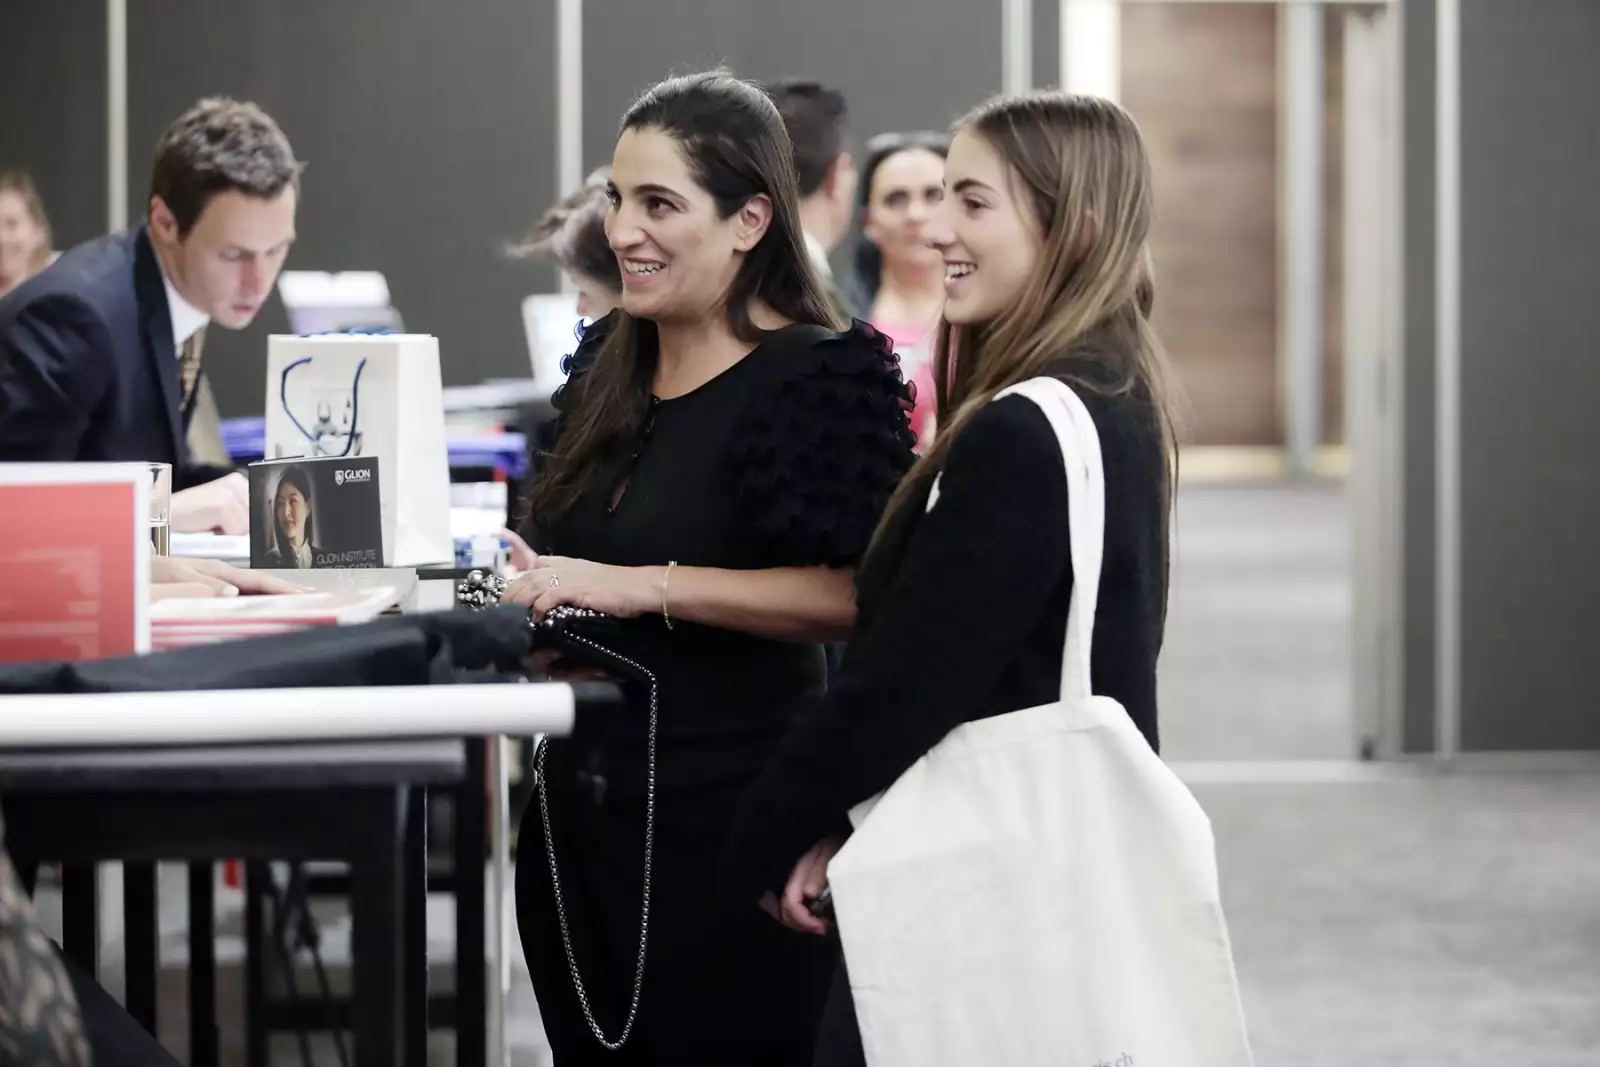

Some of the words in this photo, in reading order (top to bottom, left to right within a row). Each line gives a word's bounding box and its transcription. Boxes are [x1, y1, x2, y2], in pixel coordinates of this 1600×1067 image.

[345, 469, 371, 479] GLION
[316, 552, 340, 565] GLION
[341, 549, 377, 562] INSTITUTE
